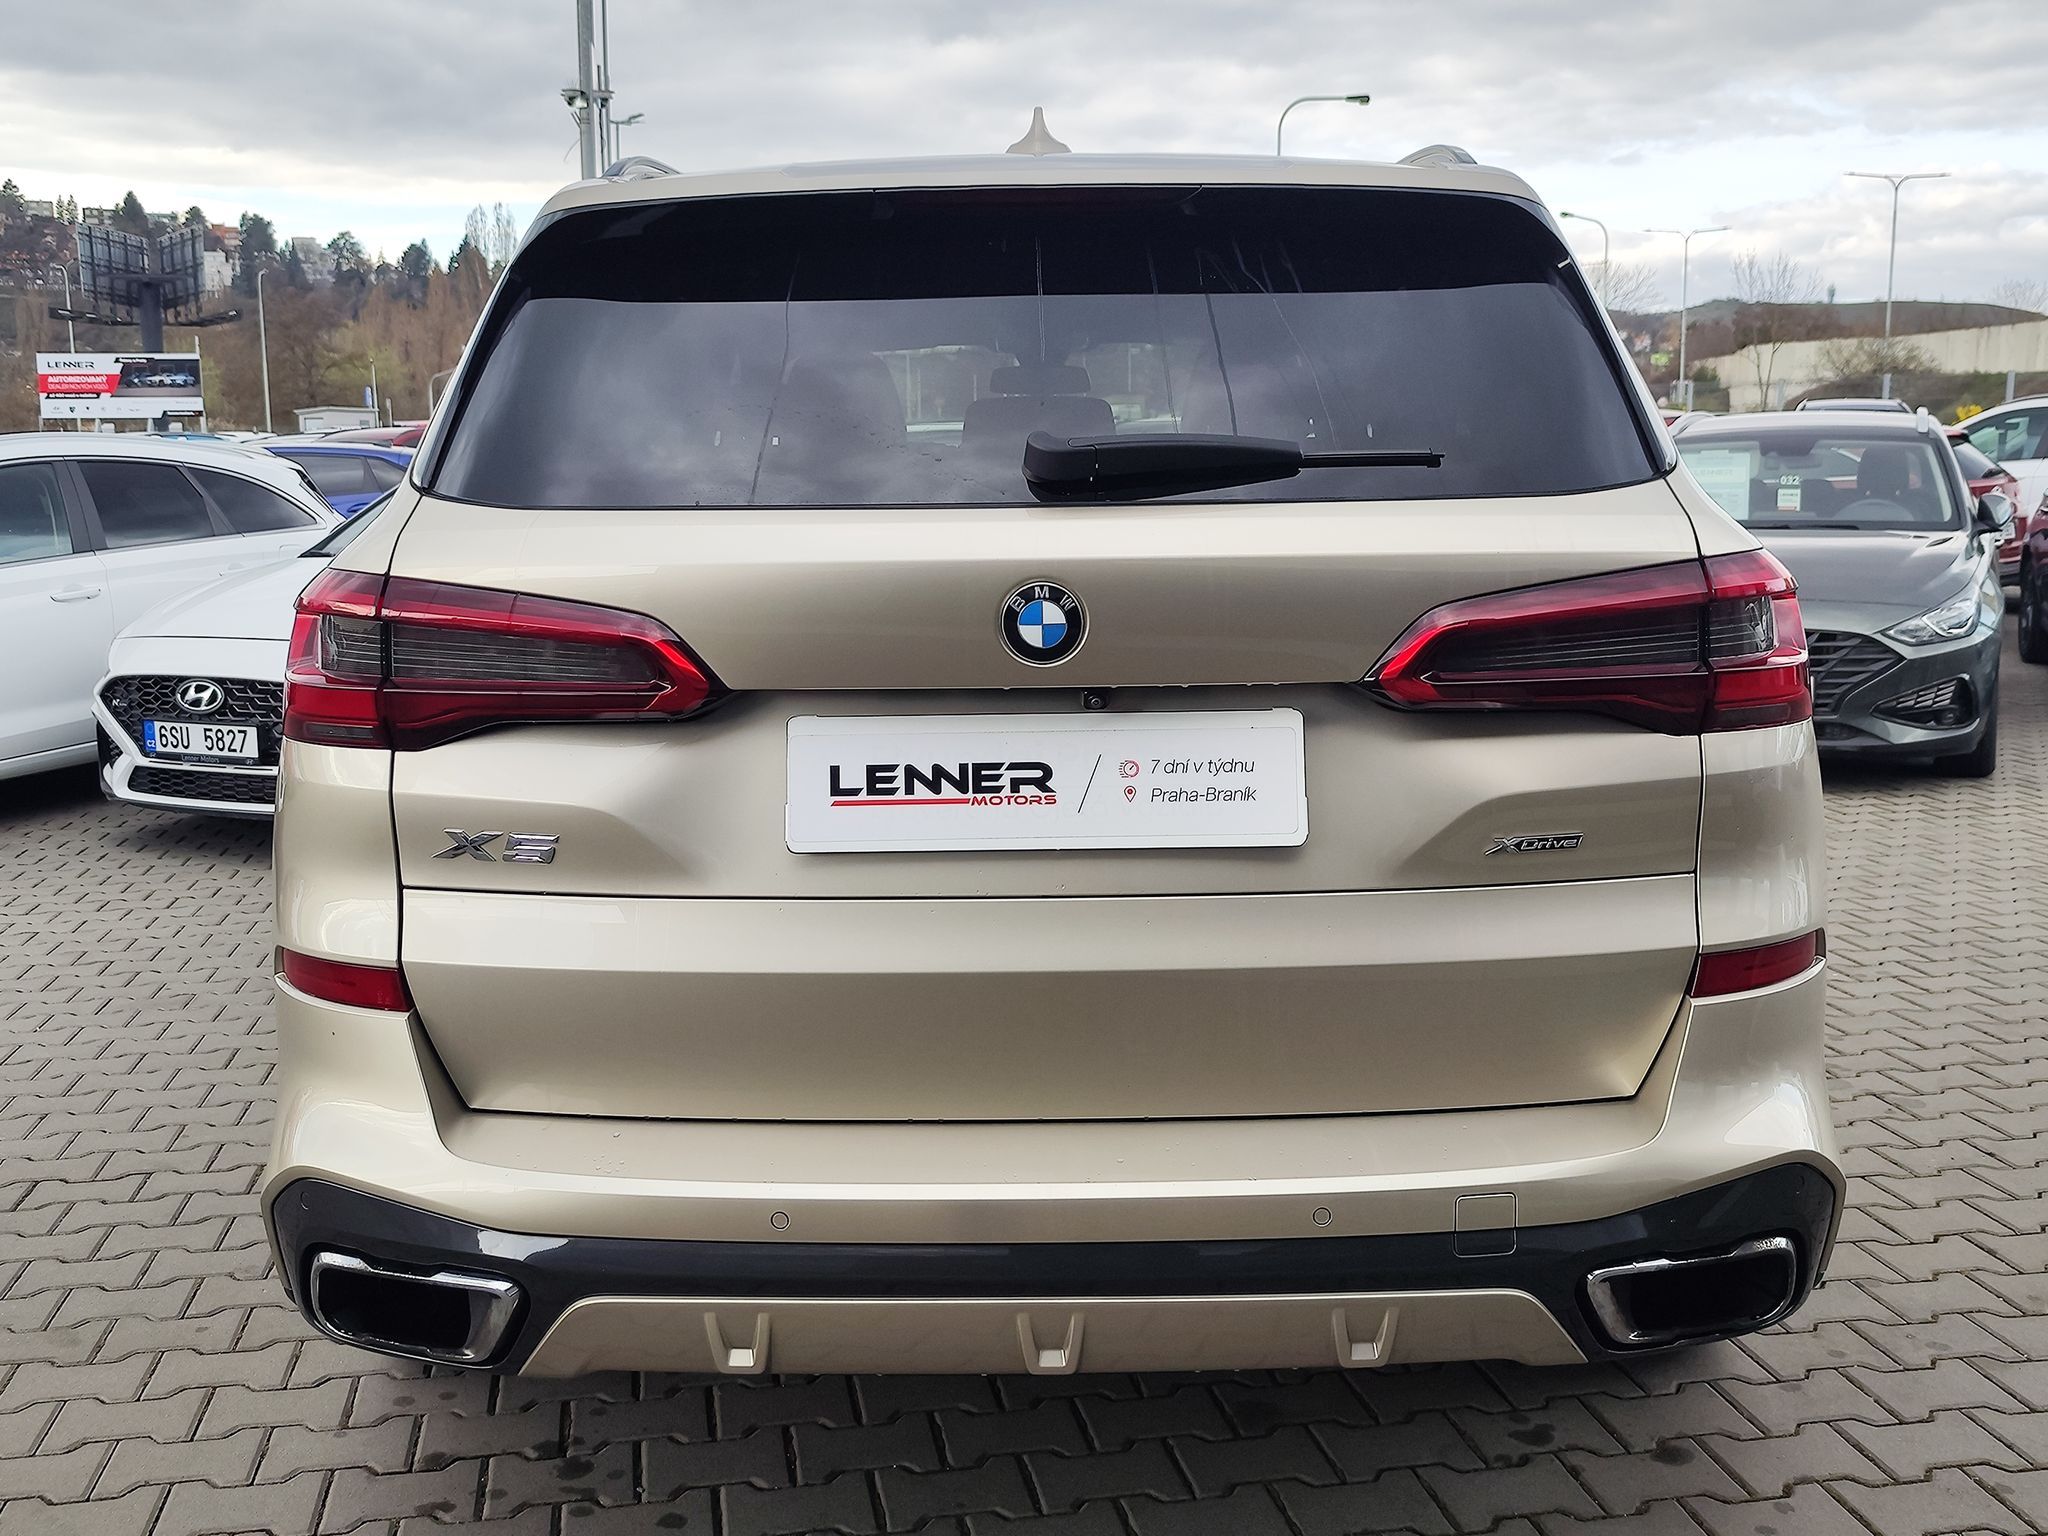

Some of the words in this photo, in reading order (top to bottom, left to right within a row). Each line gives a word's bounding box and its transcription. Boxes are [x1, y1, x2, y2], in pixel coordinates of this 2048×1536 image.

[47, 361, 95, 369] LENNER
[1009, 586, 1076, 612] BMW
[146, 739, 156, 747] CZ
[158, 725, 190, 750] 6SU
[203, 727, 248, 754] 5827
[181, 754, 200, 763] Lenner
[200, 755, 220, 764] Motors
[1151, 759, 1161, 774] 7
[1163, 758, 1190, 774] dní
[1193, 761, 1204, 773] v
[1207, 758, 1255, 777] týdnu
[829, 761, 1057, 797] LENNER
[970, 795, 1057, 806] MOTORS
[1150, 786, 1257, 802] Praha-Braník
[430, 827, 560, 865] X5
